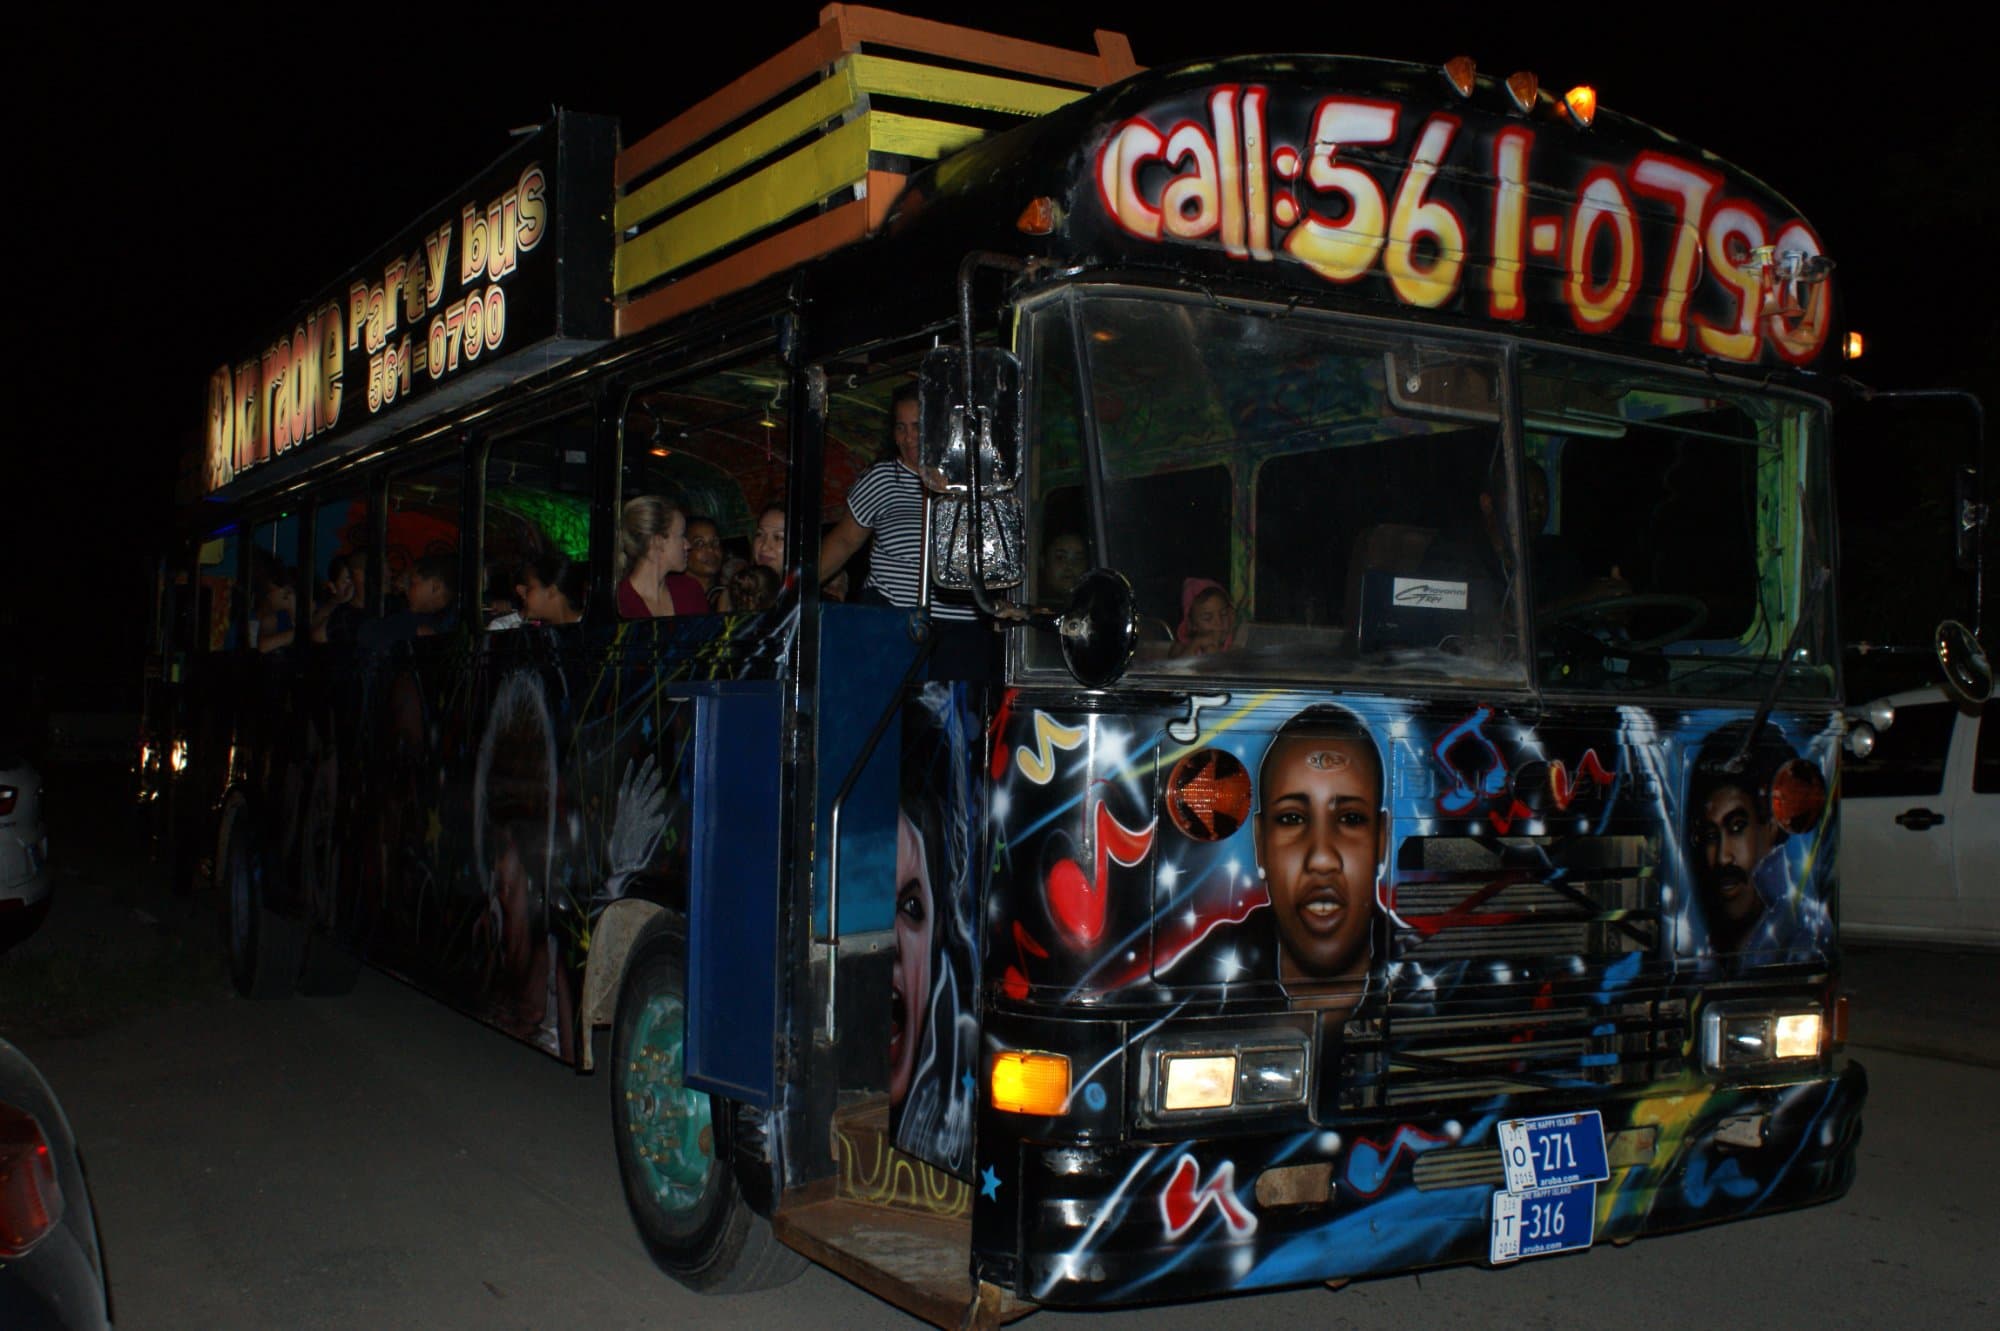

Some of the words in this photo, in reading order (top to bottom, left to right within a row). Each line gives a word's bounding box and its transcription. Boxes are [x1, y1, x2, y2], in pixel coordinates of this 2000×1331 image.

[1282, 97, 1832, 365] 561-0790
[349, 222, 451, 354] Party
[367, 284, 506, 413] 561-0790
[1538, 1118, 1556, 1130] HAPPY
[1556, 1116, 1577, 1127] ISLAND
[1541, 1174, 1580, 1186] aruba.com
[1522, 1241, 1563, 1254] aruba.com
